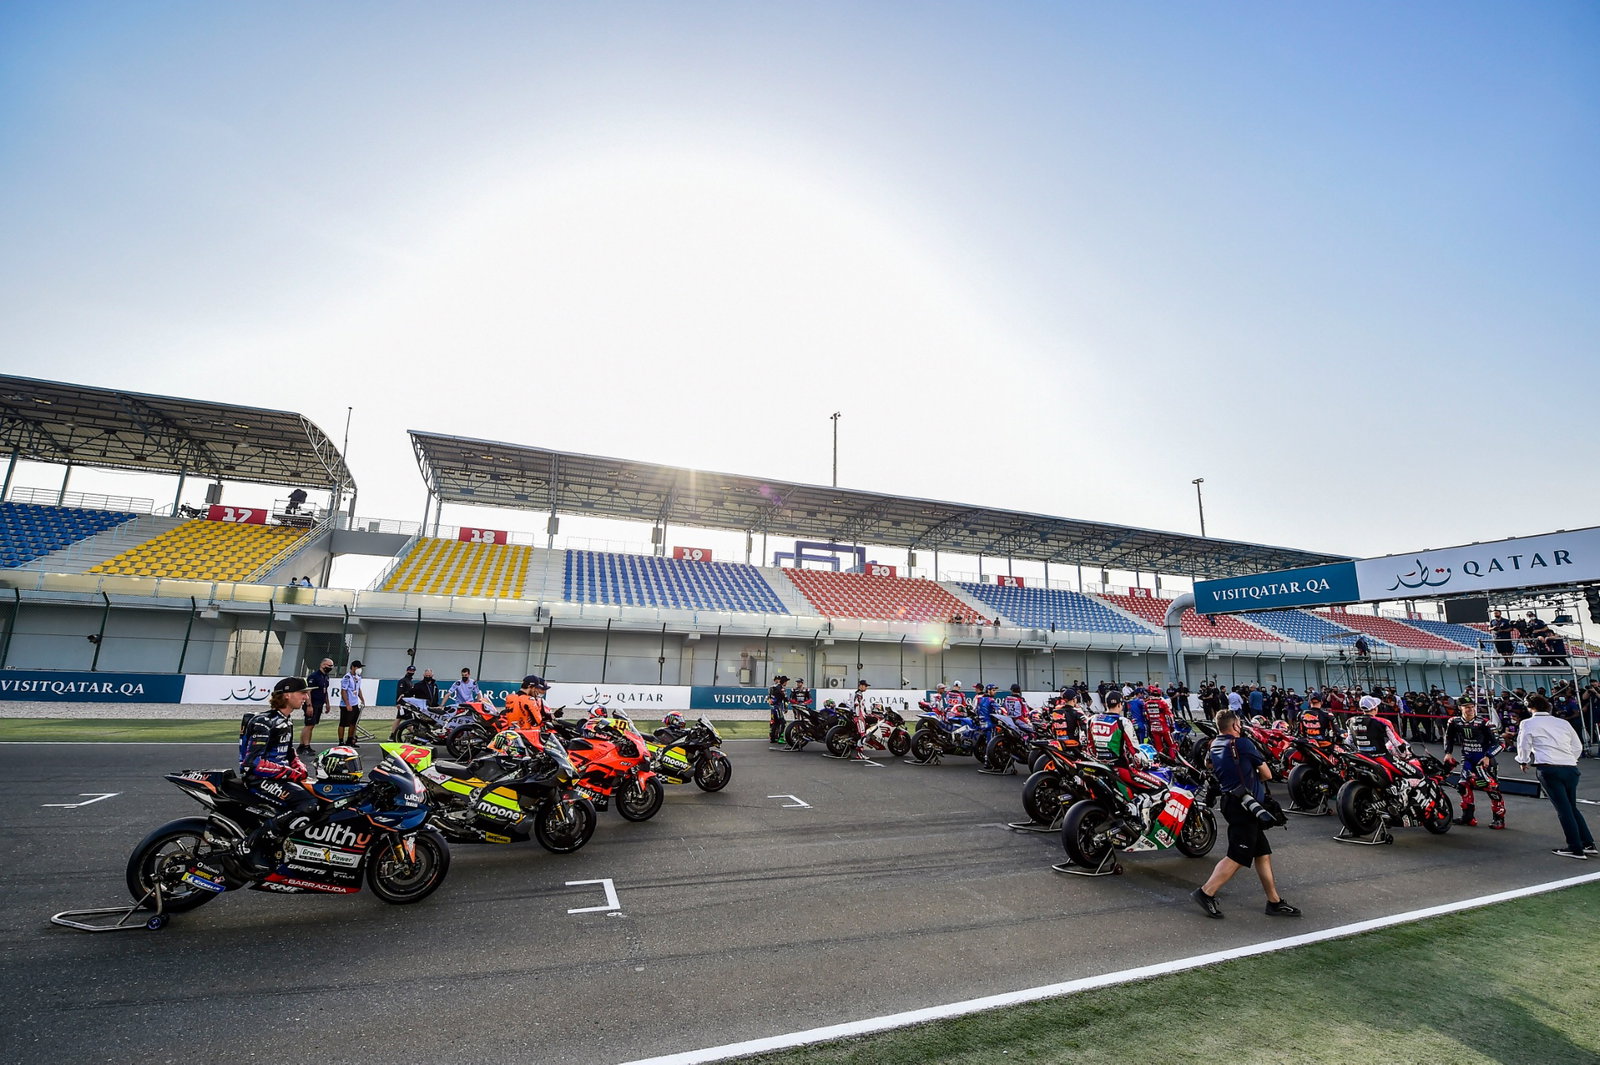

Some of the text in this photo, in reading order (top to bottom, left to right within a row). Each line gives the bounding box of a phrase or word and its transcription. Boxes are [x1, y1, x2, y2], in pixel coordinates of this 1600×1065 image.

[222, 508, 252, 522] 17
[471, 529, 495, 543] 18
[683, 549, 702, 560] 19
[1463, 549, 1572, 577] QATAR
[872, 565, 890, 576] 20
[1212, 578, 1330, 601] VISITQATAR.QA
[1, 680, 144, 696] VISITQATAR.QA
[617, 692, 663, 703] QATAR
[870, 696, 905, 704] QATAR
[662, 756, 692, 772] mooney
[477, 802, 527, 824] mooney
[302, 848, 322, 858] Green
[332, 853, 354, 863] Power
[288, 879, 347, 893] BARRACUDA
